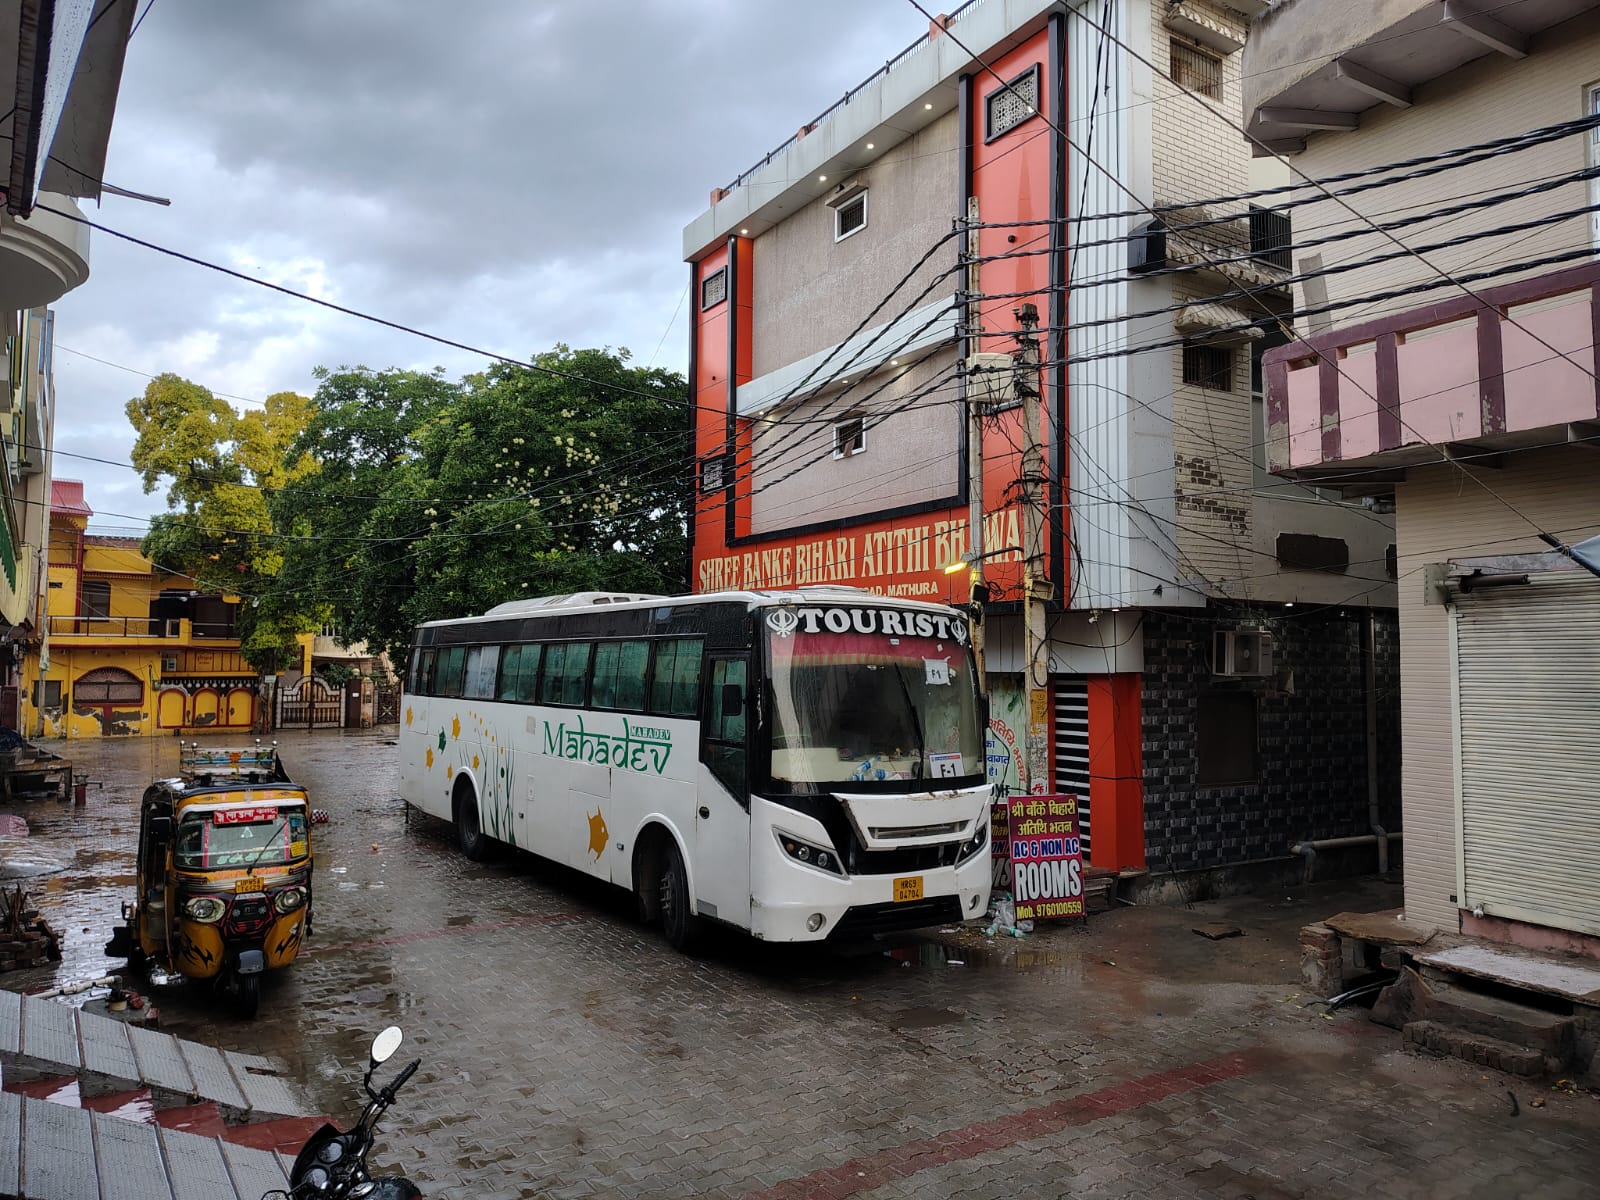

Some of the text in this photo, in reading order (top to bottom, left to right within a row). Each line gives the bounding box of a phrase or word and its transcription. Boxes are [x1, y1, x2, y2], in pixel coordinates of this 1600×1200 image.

[699, 555, 741, 593] SHREE
[743, 547, 793, 590] BANKE
[795, 537, 855, 585] BIHARI
[861, 525, 930, 577] ATITHI
[887, 581, 938, 597] MATHURA
[797, 608, 950, 639] TOURIST
[931, 668, 942, 680] F1
[630, 726, 671, 740] MAHADEV
[542, 714, 672, 774] Mahadev
[940, 763, 956, 778] F-1
[1012, 801, 1024, 817] श्री
[1018, 819, 1047, 836] अतिथि
[1049, 821, 1073, 834] भवन
[1013, 838, 1079, 858] AC & NON AC
[1014, 859, 1082, 901] ROOMS
[1016, 901, 1082, 919] Mob. 9760100559
